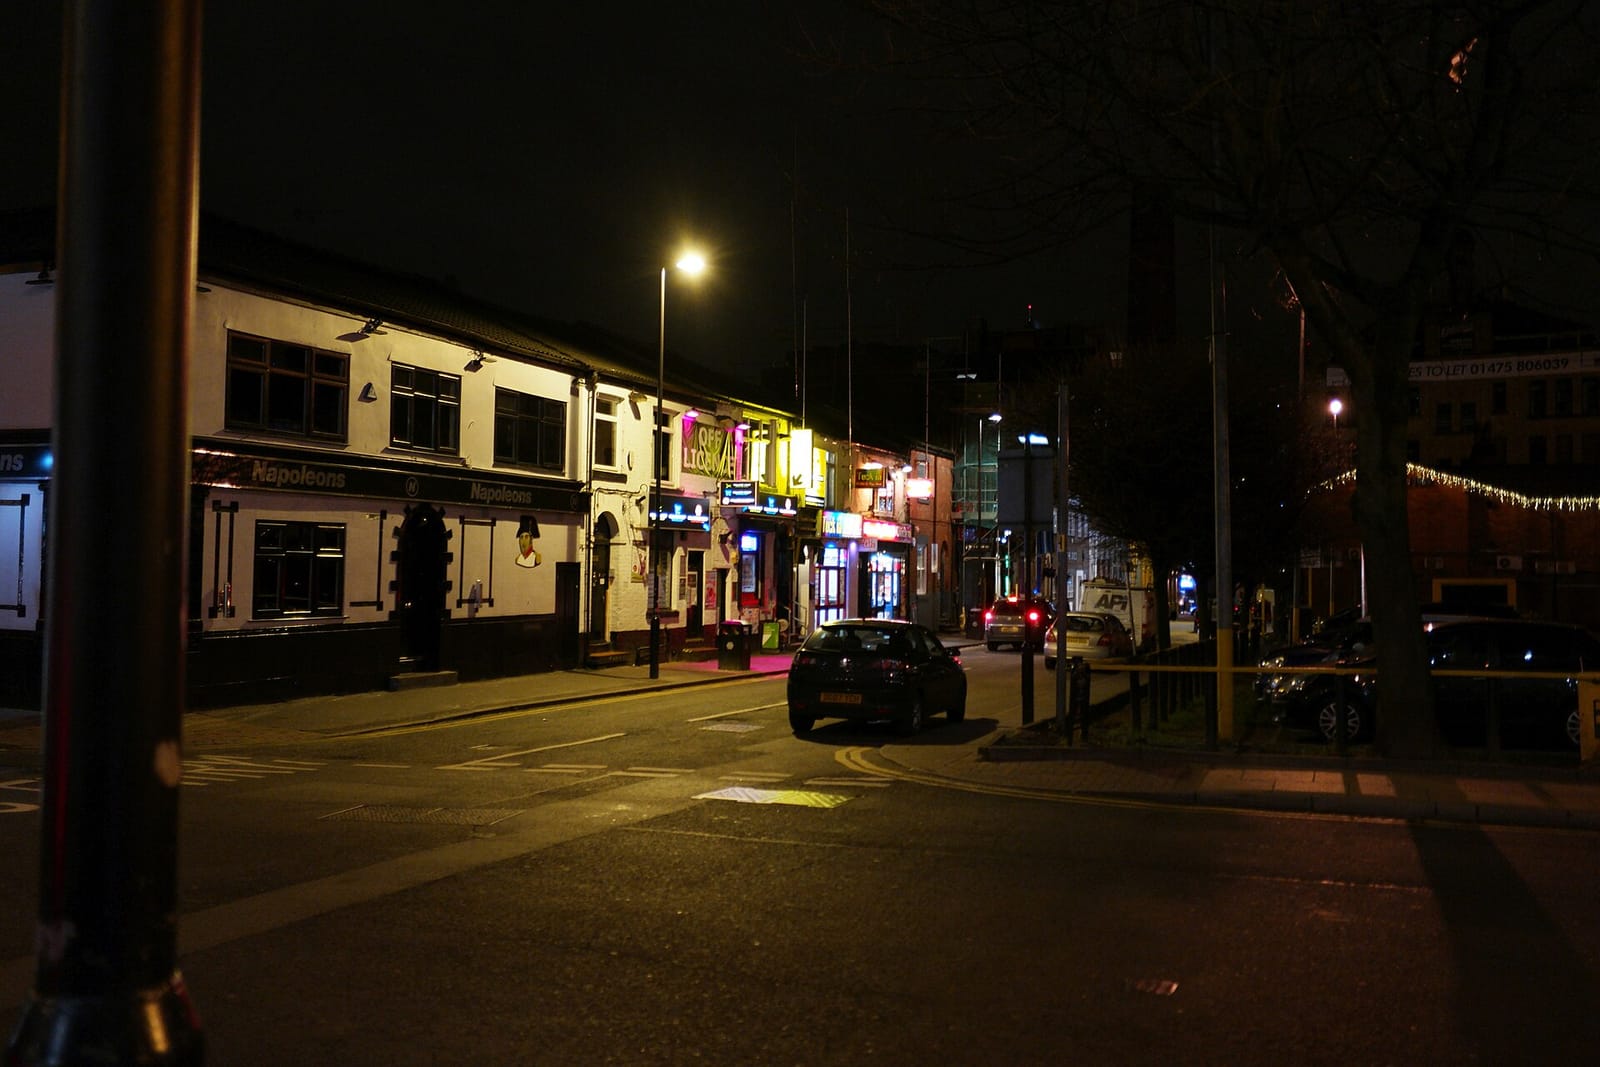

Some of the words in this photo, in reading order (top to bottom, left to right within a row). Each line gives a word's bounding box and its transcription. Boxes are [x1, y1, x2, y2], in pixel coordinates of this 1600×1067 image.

[1426, 365, 1443, 377] TO
[1447, 363, 1466, 377] LET
[1470, 361, 1513, 375] 01475
[1516, 358, 1569, 372] 806039
[698, 426, 722, 450] OFF
[251, 459, 346, 489] Napoleons
[470, 482, 532, 505] Napoleons
